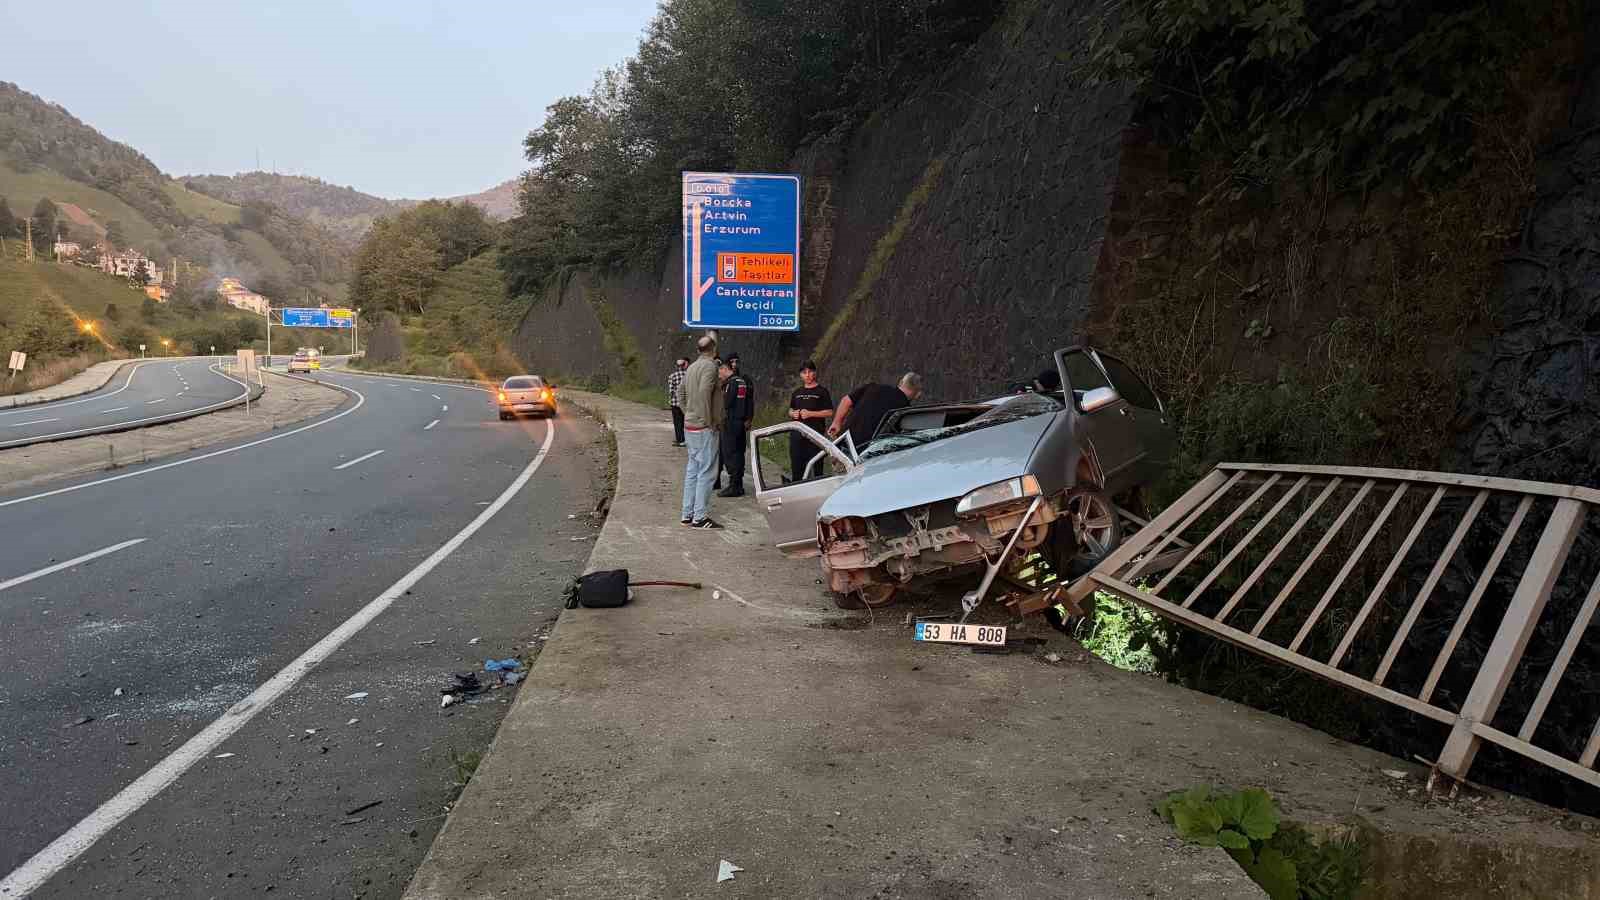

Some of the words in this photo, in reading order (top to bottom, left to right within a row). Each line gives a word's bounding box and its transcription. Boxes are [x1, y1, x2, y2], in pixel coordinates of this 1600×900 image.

[704, 211, 747, 221] Artvin
[704, 224, 761, 235] Erzurum
[716, 287, 793, 297] Cankurtaran
[762, 316, 782, 325] 300
[924, 625, 940, 639] 53
[950, 626, 967, 640] HA
[977, 627, 1003, 642] 808
